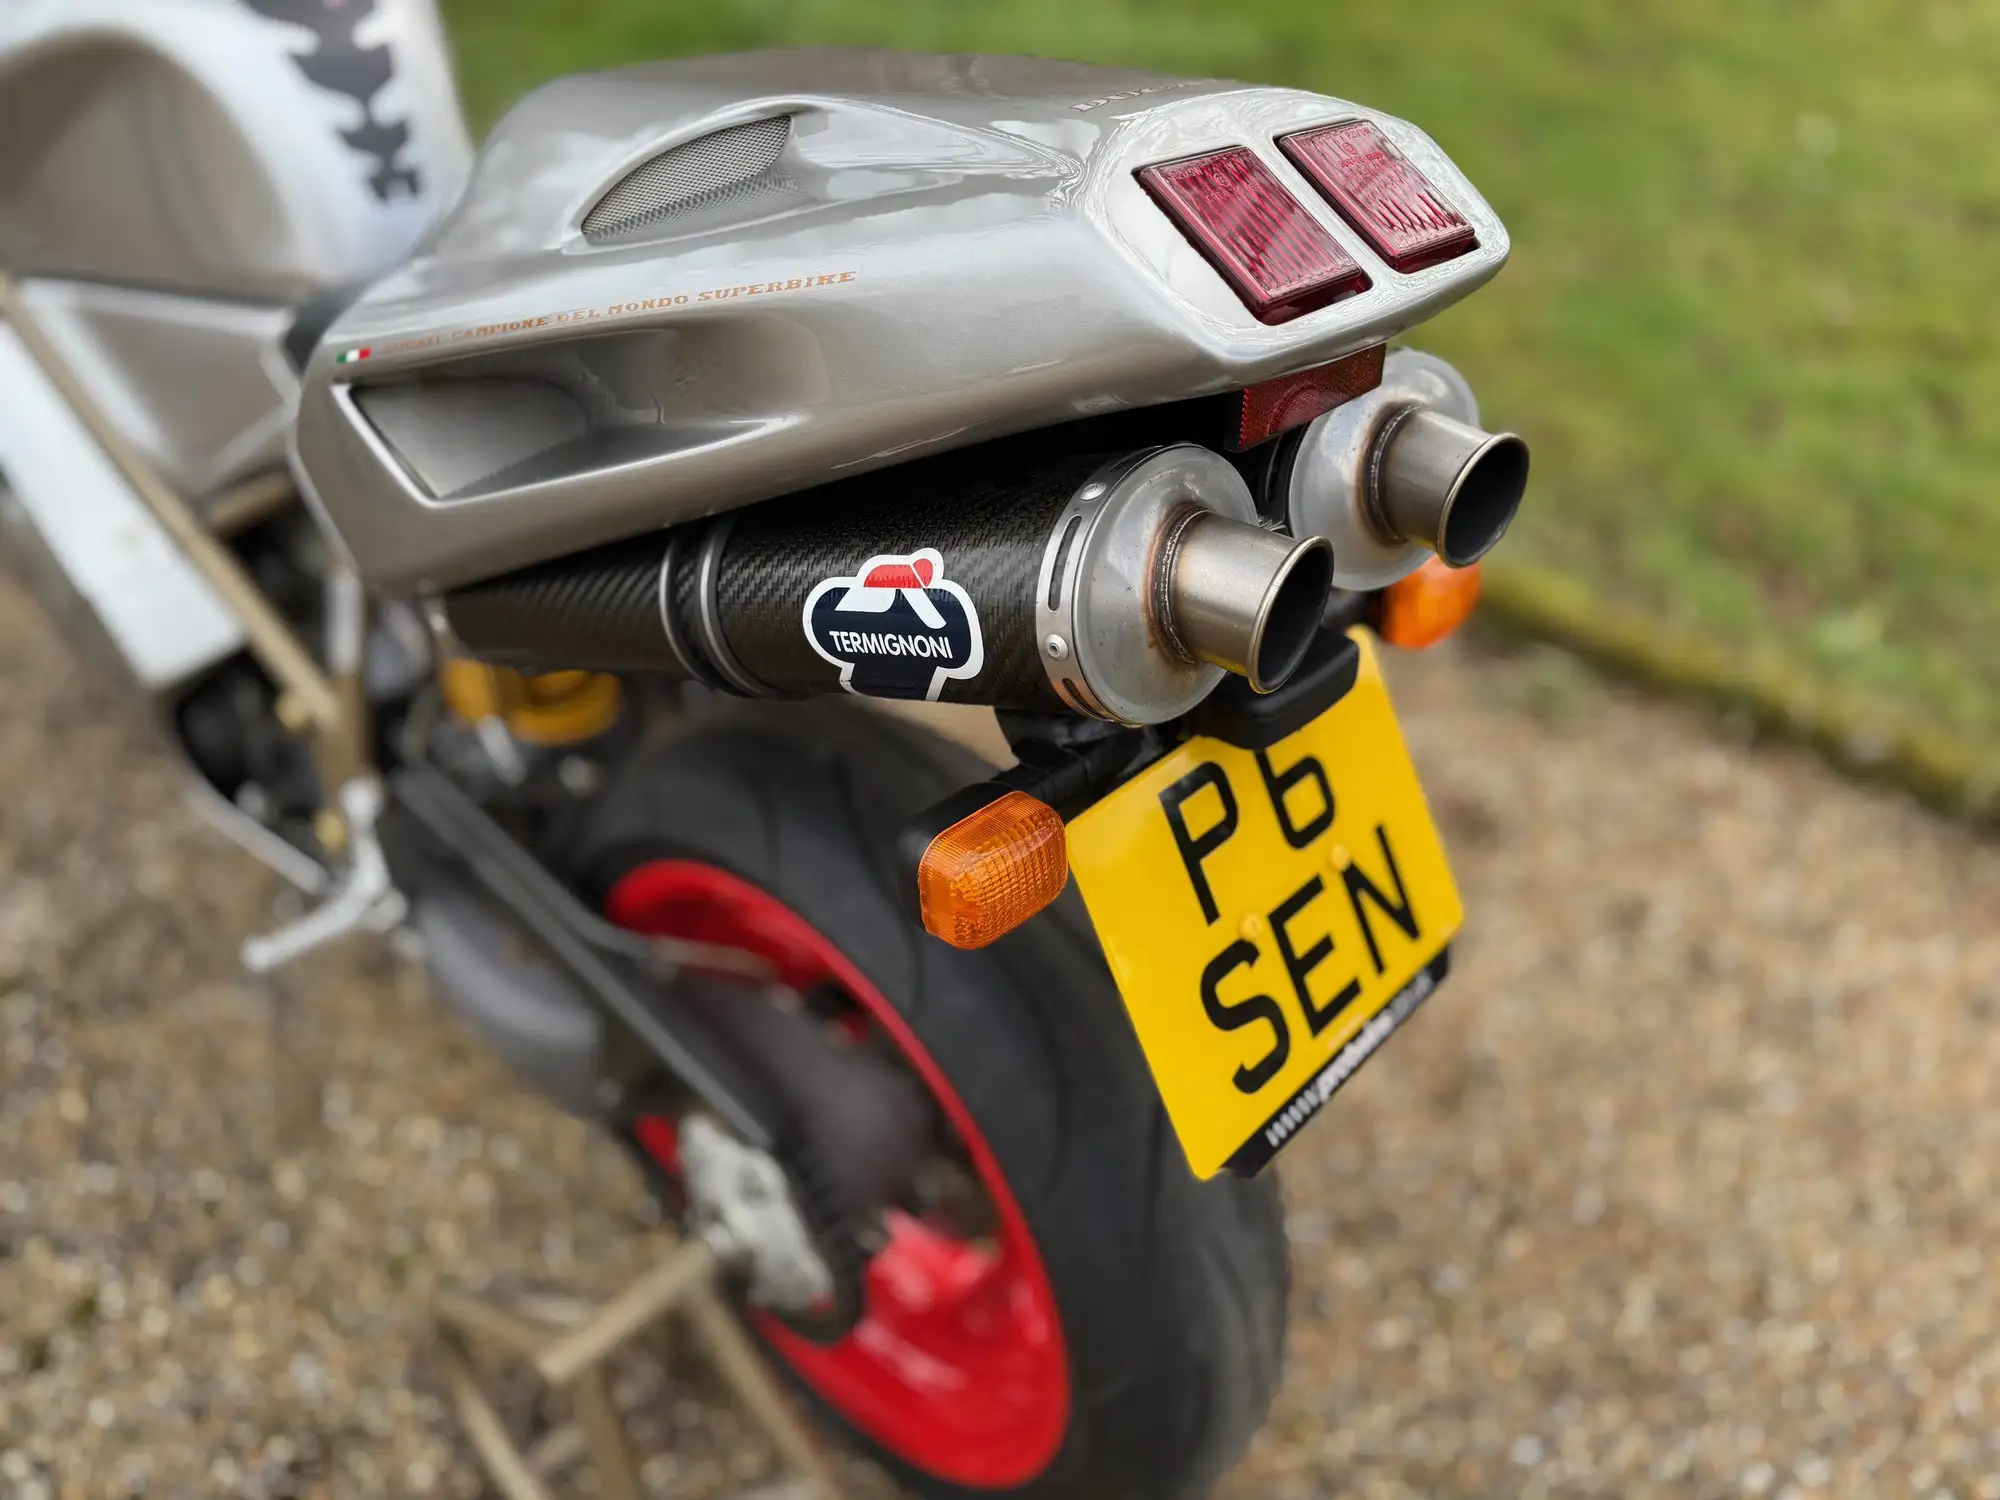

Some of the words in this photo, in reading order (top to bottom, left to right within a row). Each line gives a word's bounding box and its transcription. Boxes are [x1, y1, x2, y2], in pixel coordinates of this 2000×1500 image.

[452, 316, 549, 341] CAMPIONE
[556, 308, 600, 323] DEL
[608, 294, 689, 315] MONDO
[697, 270, 857, 302] SUPERBIKE
[828, 630, 953, 660] TERMIGNONI
[1200, 820, 1421, 1095] SEN
